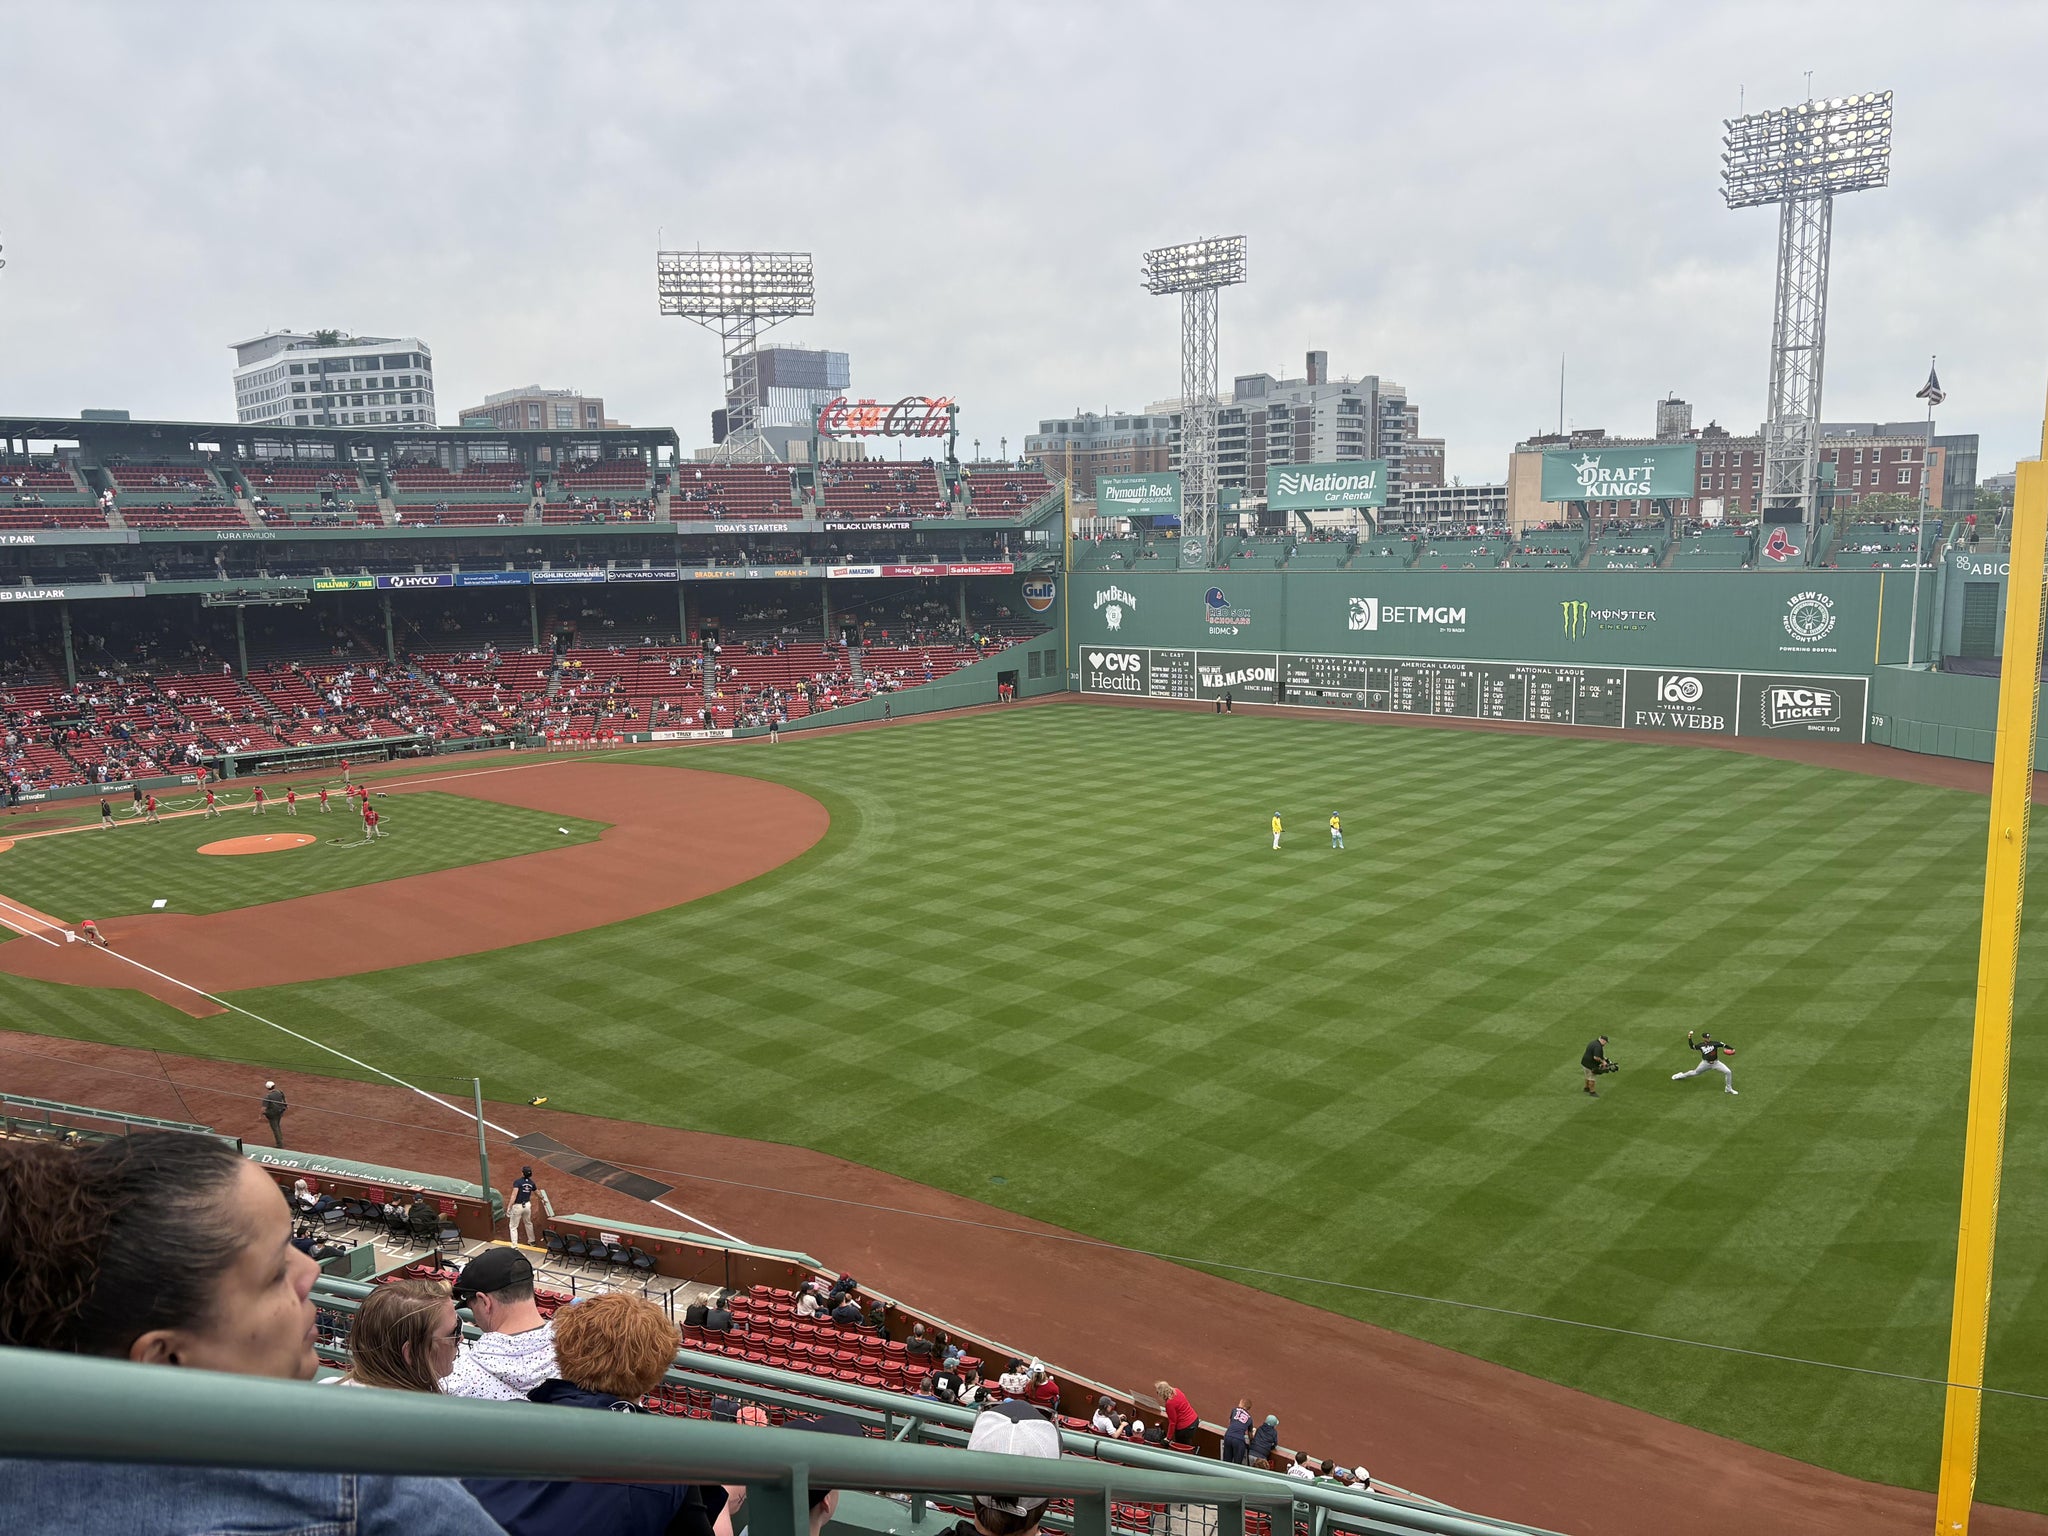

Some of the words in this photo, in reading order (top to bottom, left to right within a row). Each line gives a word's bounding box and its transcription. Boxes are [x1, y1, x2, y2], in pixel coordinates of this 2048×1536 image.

[818, 396, 955, 438] Coca-Cola
[1576, 466, 1655, 486] DRAFT
[1105, 485, 1147, 501] Plymouth
[1149, 484, 1173, 497] Rock
[1324, 493, 1341, 501] Car
[1342, 491, 1372, 500] Rental
[1585, 482, 1651, 497] KINGS
[714, 524, 747, 533] TODAY'S
[749, 523, 788, 532] STARTERS
[837, 522, 860, 530] BLACK
[861, 522, 881, 530] LIVES
[9, 535, 36, 544] PARK
[950, 566, 981, 574] Safelite
[316, 580, 349, 589] SULLIVAN
[406, 577, 437, 585] HYCU
[16, 590, 64, 600] BALLPARK
[1022, 583, 1054, 598] Gulf
[1787, 591, 1816, 607] IBEW
[1816, 593, 1834, 608] 103
[1210, 609, 1229, 617] RED
[1231, 609, 1250, 617] SOX
[1382, 606, 1466, 624] BETMGM
[1591, 609, 1656, 620] MONSTER
[1209, 626, 1231, 635] BIDMC
[1783, 615, 1792, 634] NECA
[1791, 615, 1836, 642] CONTRACTORS
[1105, 652, 1141, 672] CVS
[1090, 671, 1141, 691] Health
[1657, 675, 1704, 703] 160
[1777, 689, 1831, 708] ACE
[1777, 708, 1831, 719] TICKET
[1635, 711, 1666, 727] F.W.
[1670, 713, 1725, 730] WEBB
[1871, 715, 1884, 727] 379
